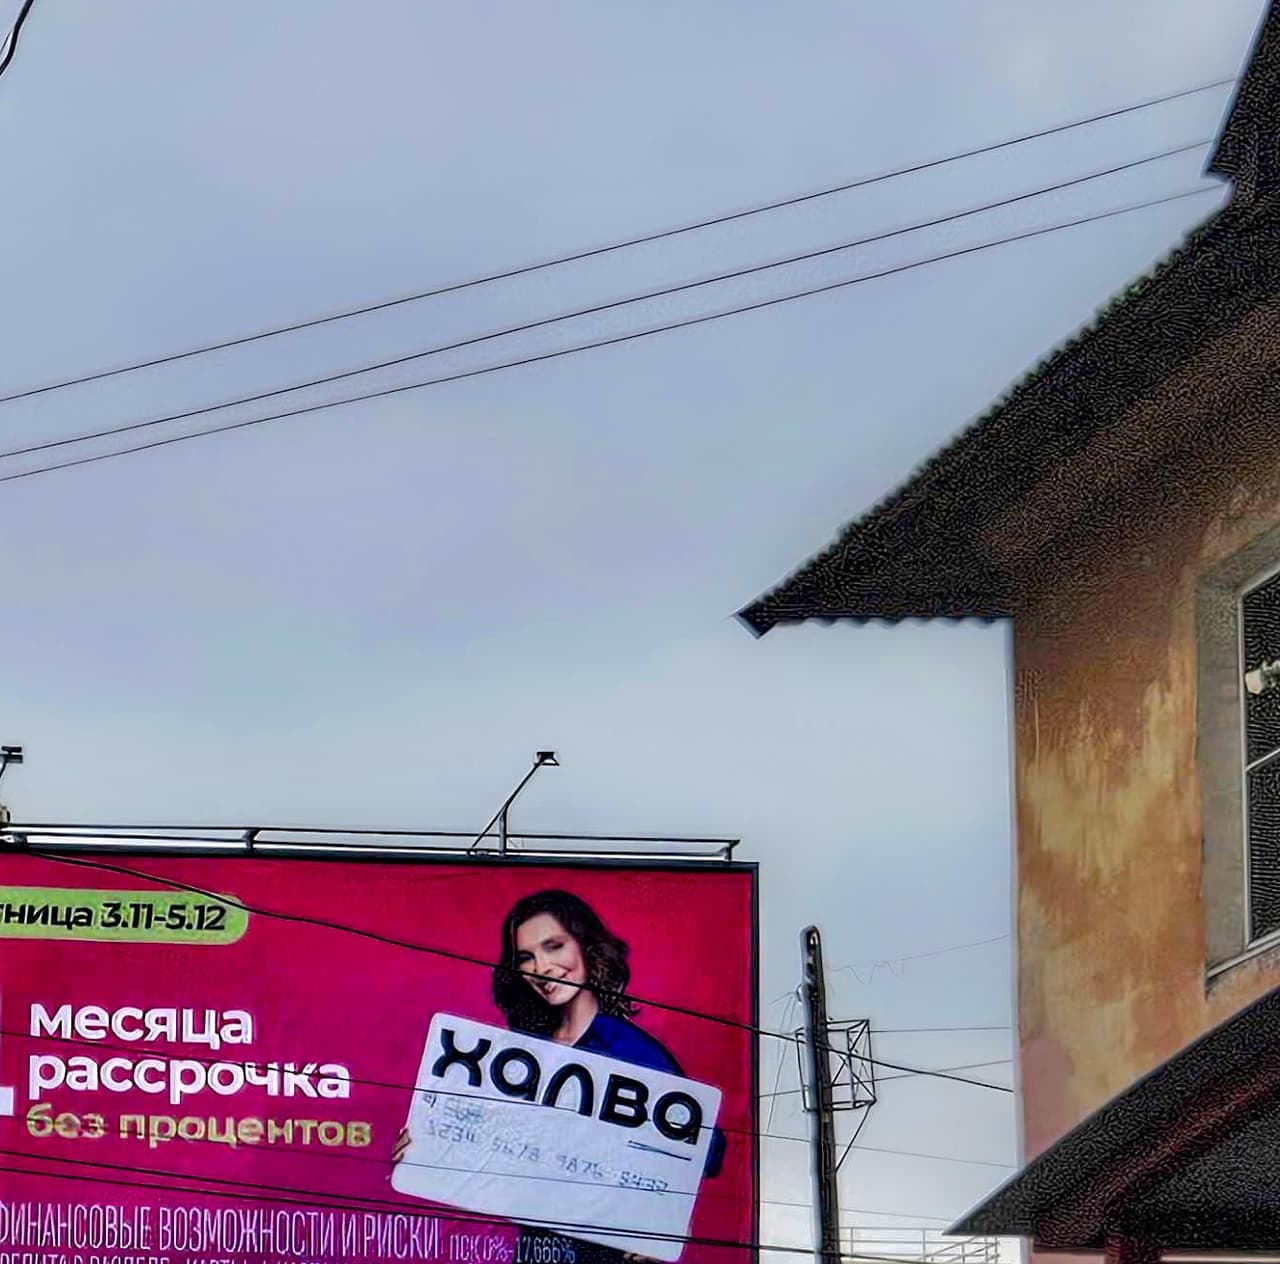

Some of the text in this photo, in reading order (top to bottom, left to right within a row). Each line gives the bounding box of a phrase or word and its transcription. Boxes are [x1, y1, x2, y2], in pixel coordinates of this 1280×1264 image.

[101, 902, 226, 931] 3.11-5.12
[30, 1002, 253, 1050] месяца
[28, 1054, 350, 1104] рассрочка
[26, 1103, 372, 1149] без процентов
[159, 1206, 335, 1256] ВОЗМОЖНОСТИ
[342, 1213, 356, 1257] И
[450, 1234, 481, 1262] ПСК
